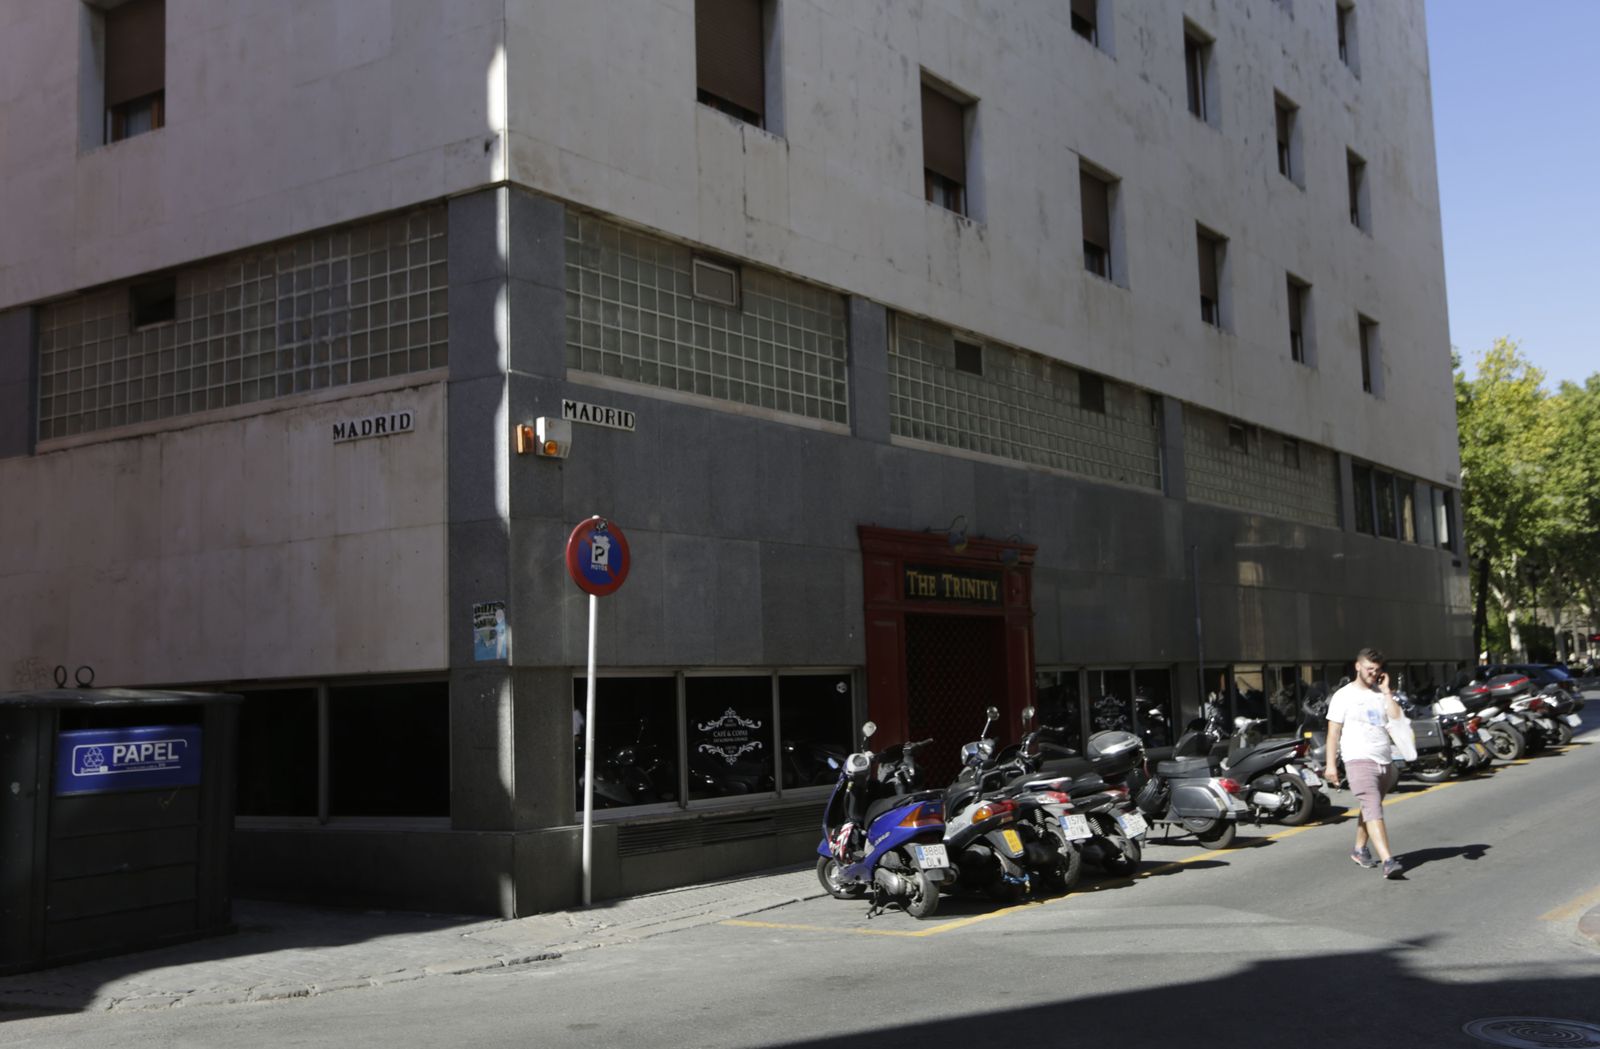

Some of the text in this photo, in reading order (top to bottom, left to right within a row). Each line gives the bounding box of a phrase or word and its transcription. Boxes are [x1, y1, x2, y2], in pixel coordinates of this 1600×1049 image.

[333, 412, 411, 440] MADRID
[564, 400, 635, 429] MADRID
[906, 571, 998, 601] THE TRINITY
[113, 743, 179, 763] PAPEL
